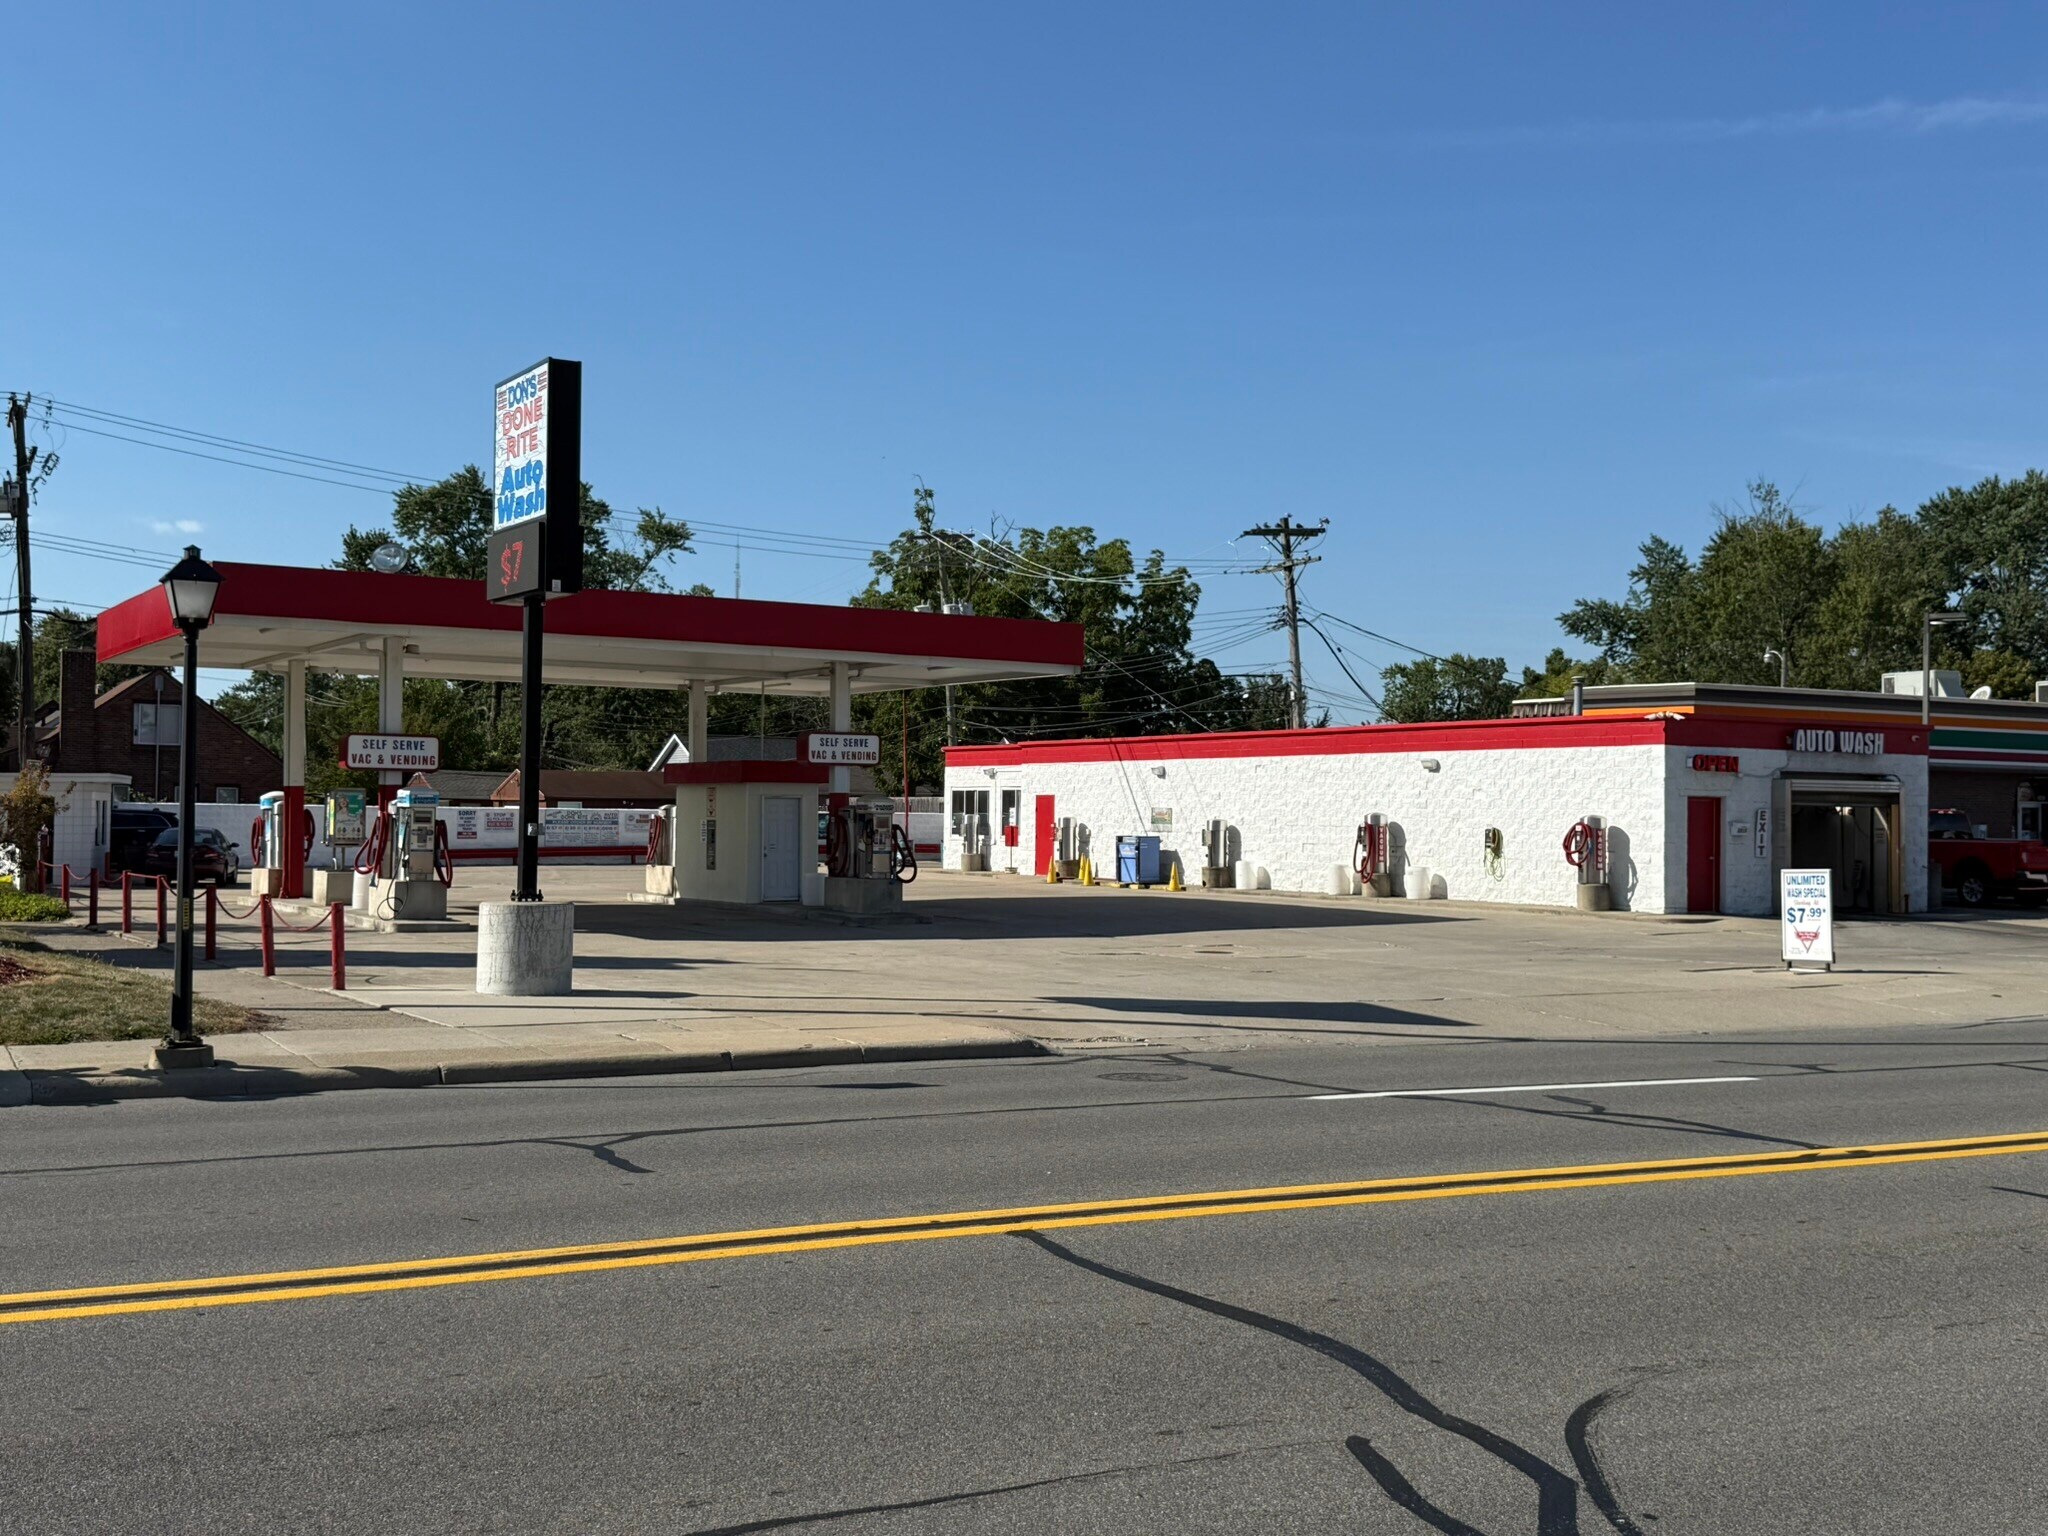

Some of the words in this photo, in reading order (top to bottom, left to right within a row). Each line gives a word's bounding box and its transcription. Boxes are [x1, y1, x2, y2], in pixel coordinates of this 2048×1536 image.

[507, 375, 537, 408] DON'S
[502, 396, 543, 436] DONE
[507, 426, 538, 460] RITE
[500, 459, 544, 496] Auto
[497, 483, 545, 524] Wash
[501, 540, 524, 594] $7
[363, 739, 387, 750] SELF
[393, 740, 425, 751] SERVE
[819, 738, 839, 747] SELF
[843, 738, 869, 748] SERVE
[1796, 729, 1834, 752] AUTO
[1840, 731, 1884, 754] WASH
[351, 754, 372, 764] VAC
[377, 754, 385, 765] &
[390, 754, 436, 766] VENDING
[811, 750, 827, 760] VAC
[831, 750, 837, 760] &
[841, 751, 877, 761] VENDING
[1693, 755, 1739, 773] OPEN
[1759, 810, 1767, 856] EXIT
[1786, 875, 1825, 885] UNLIMITED
[1787, 888, 1802, 898] WASH
[1803, 888, 1826, 898] SPECIAL
